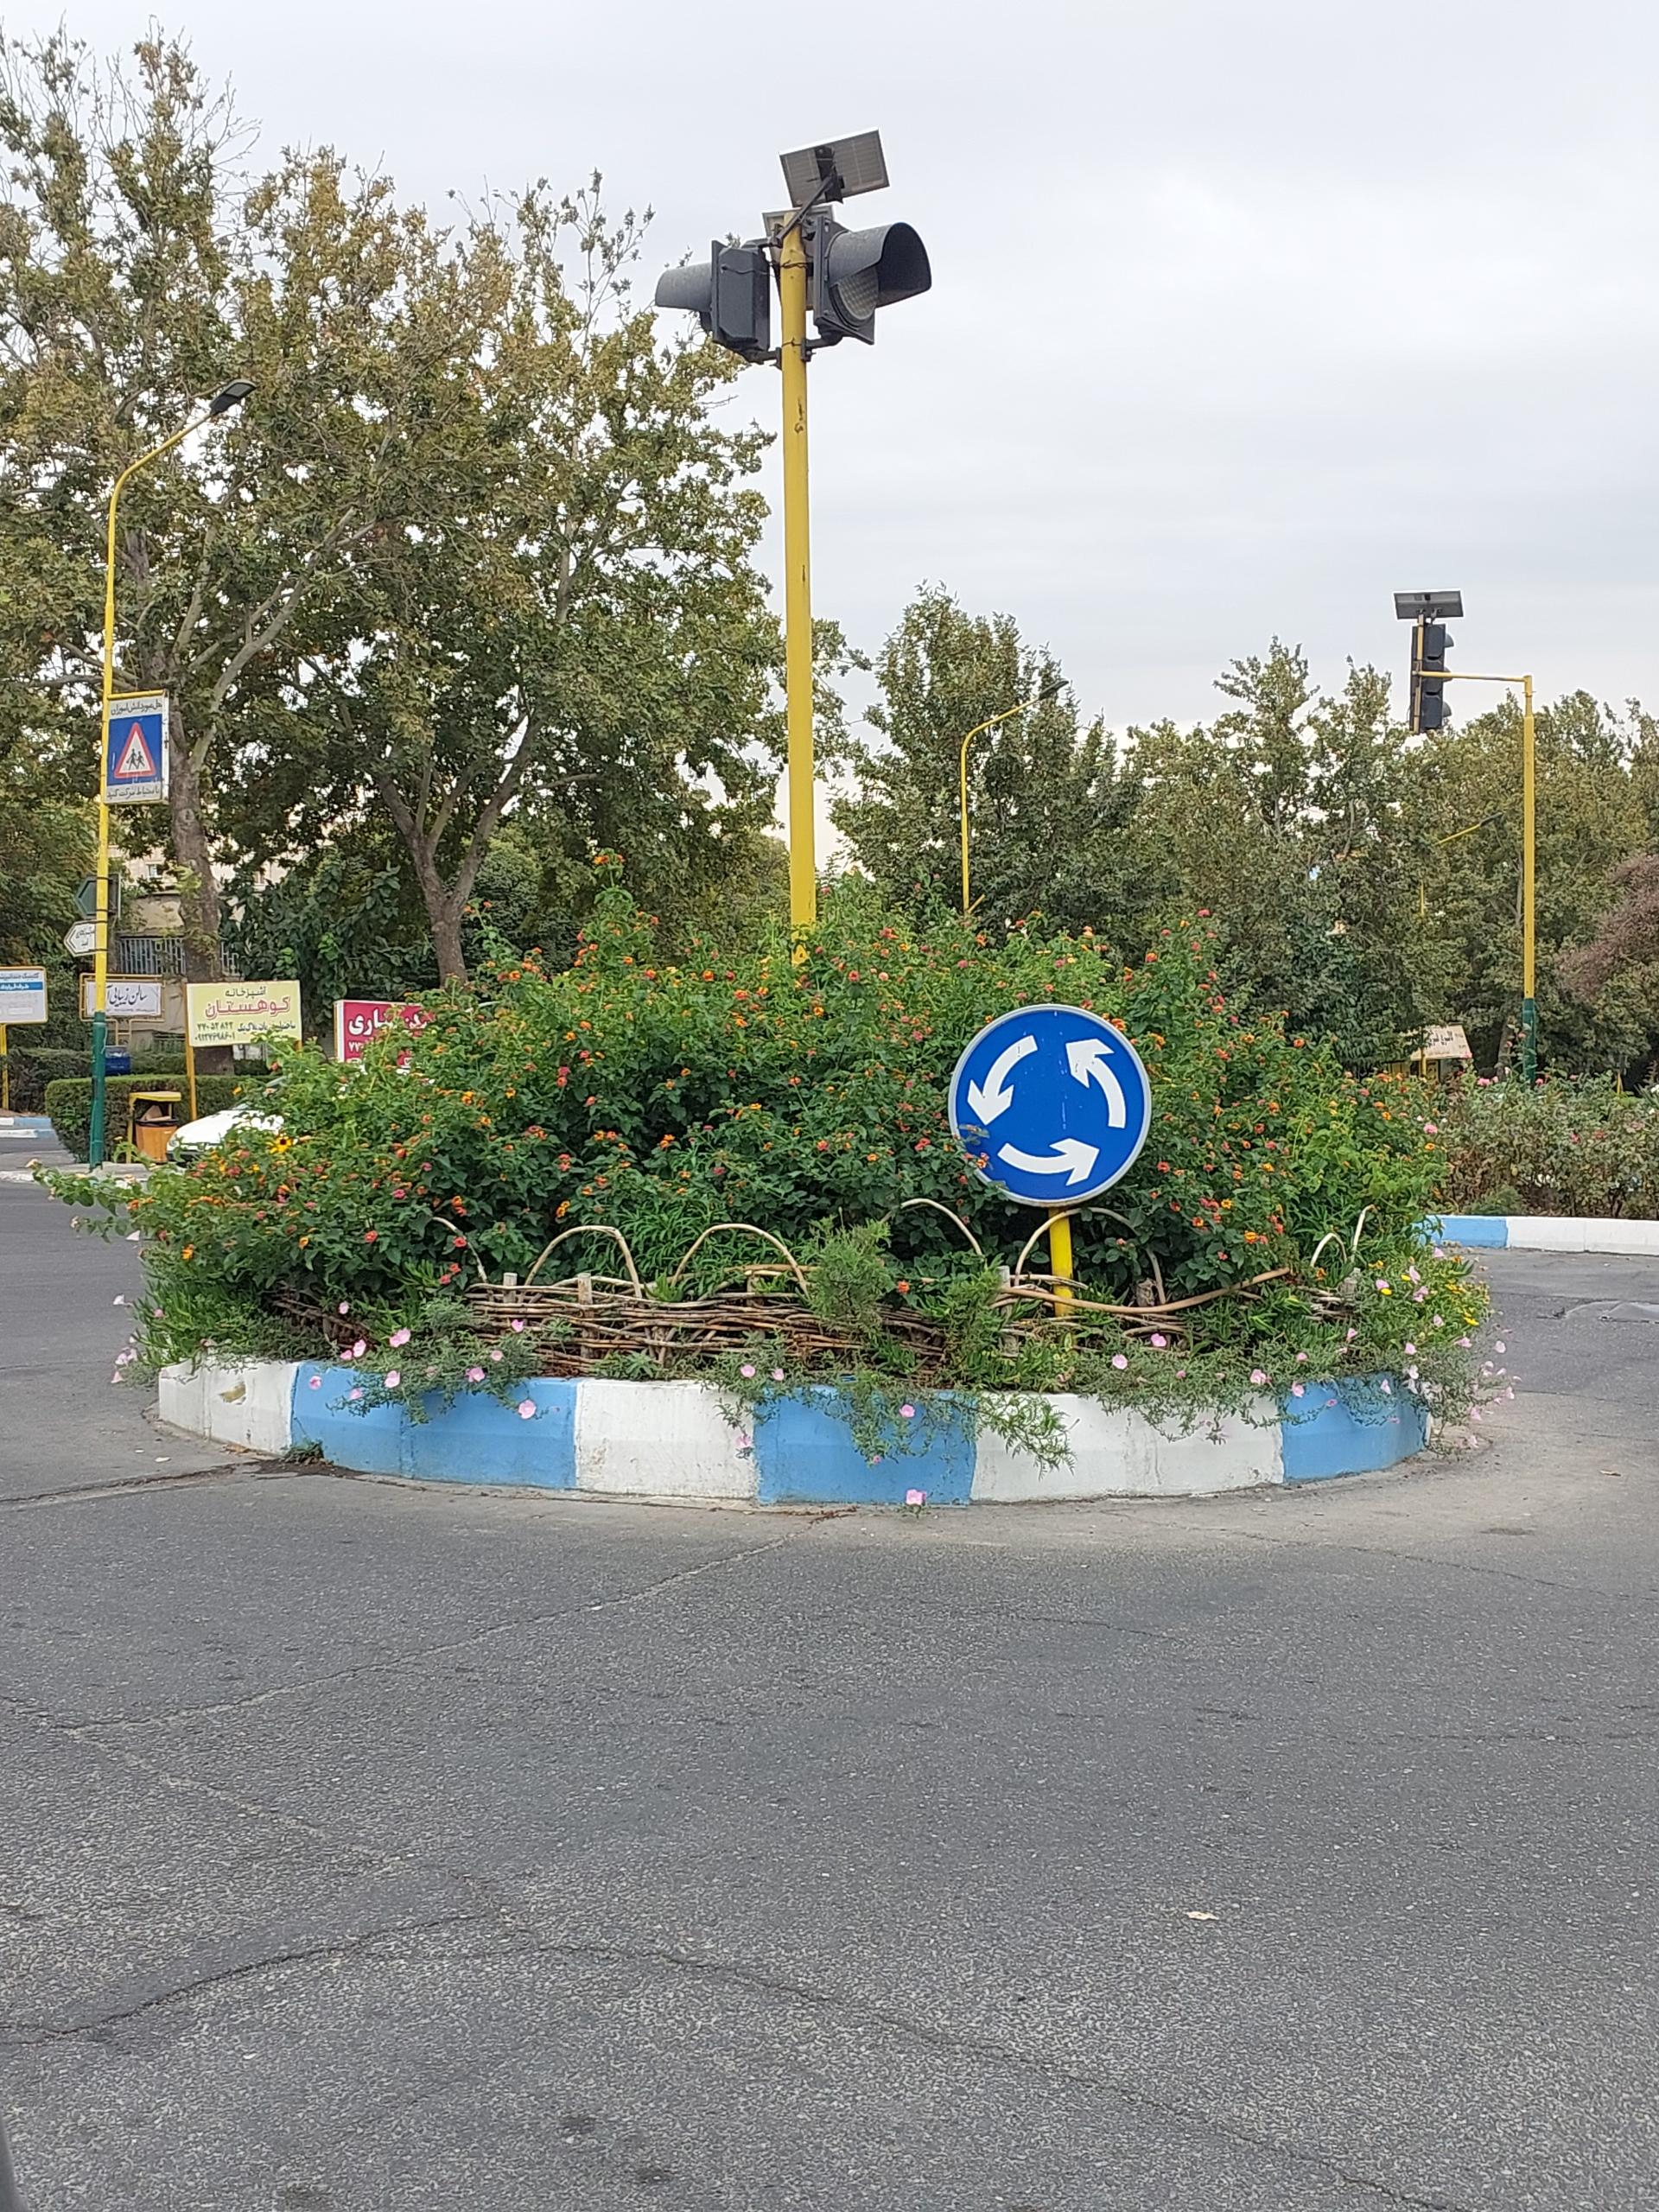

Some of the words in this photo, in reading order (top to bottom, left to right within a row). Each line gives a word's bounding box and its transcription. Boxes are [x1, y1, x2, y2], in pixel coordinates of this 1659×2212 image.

[109, 987, 129, 1007] زیبایی
[128, 984, 148, 1005] سالن
[225, 986, 266, 999] آشپزخانه
[206, 996, 290, 1020] کوهستان
